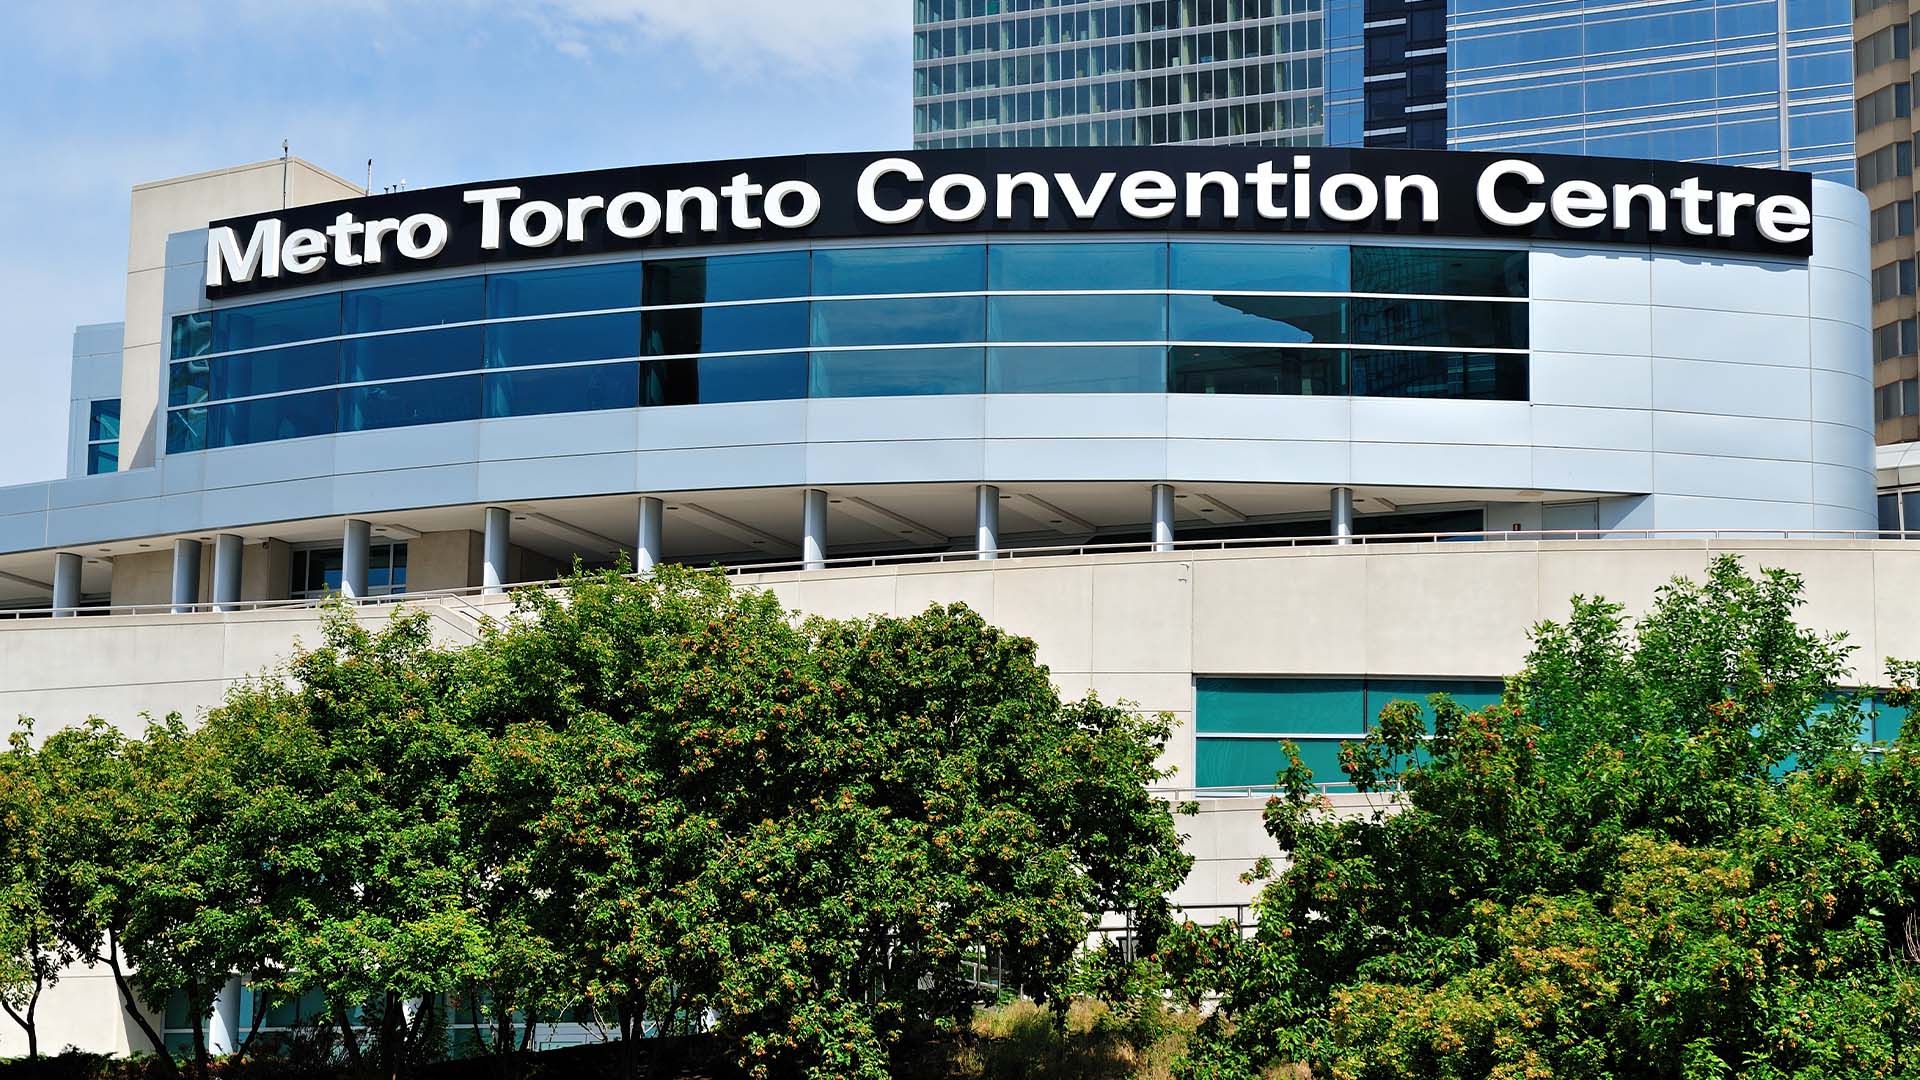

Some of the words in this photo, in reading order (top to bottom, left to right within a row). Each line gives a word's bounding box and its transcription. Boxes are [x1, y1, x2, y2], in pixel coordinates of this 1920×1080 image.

[206, 211, 448, 287] Metro
[463, 172, 821, 250] Toronto
[856, 155, 1439, 226] Convention
[1476, 159, 1811, 243] Centre
